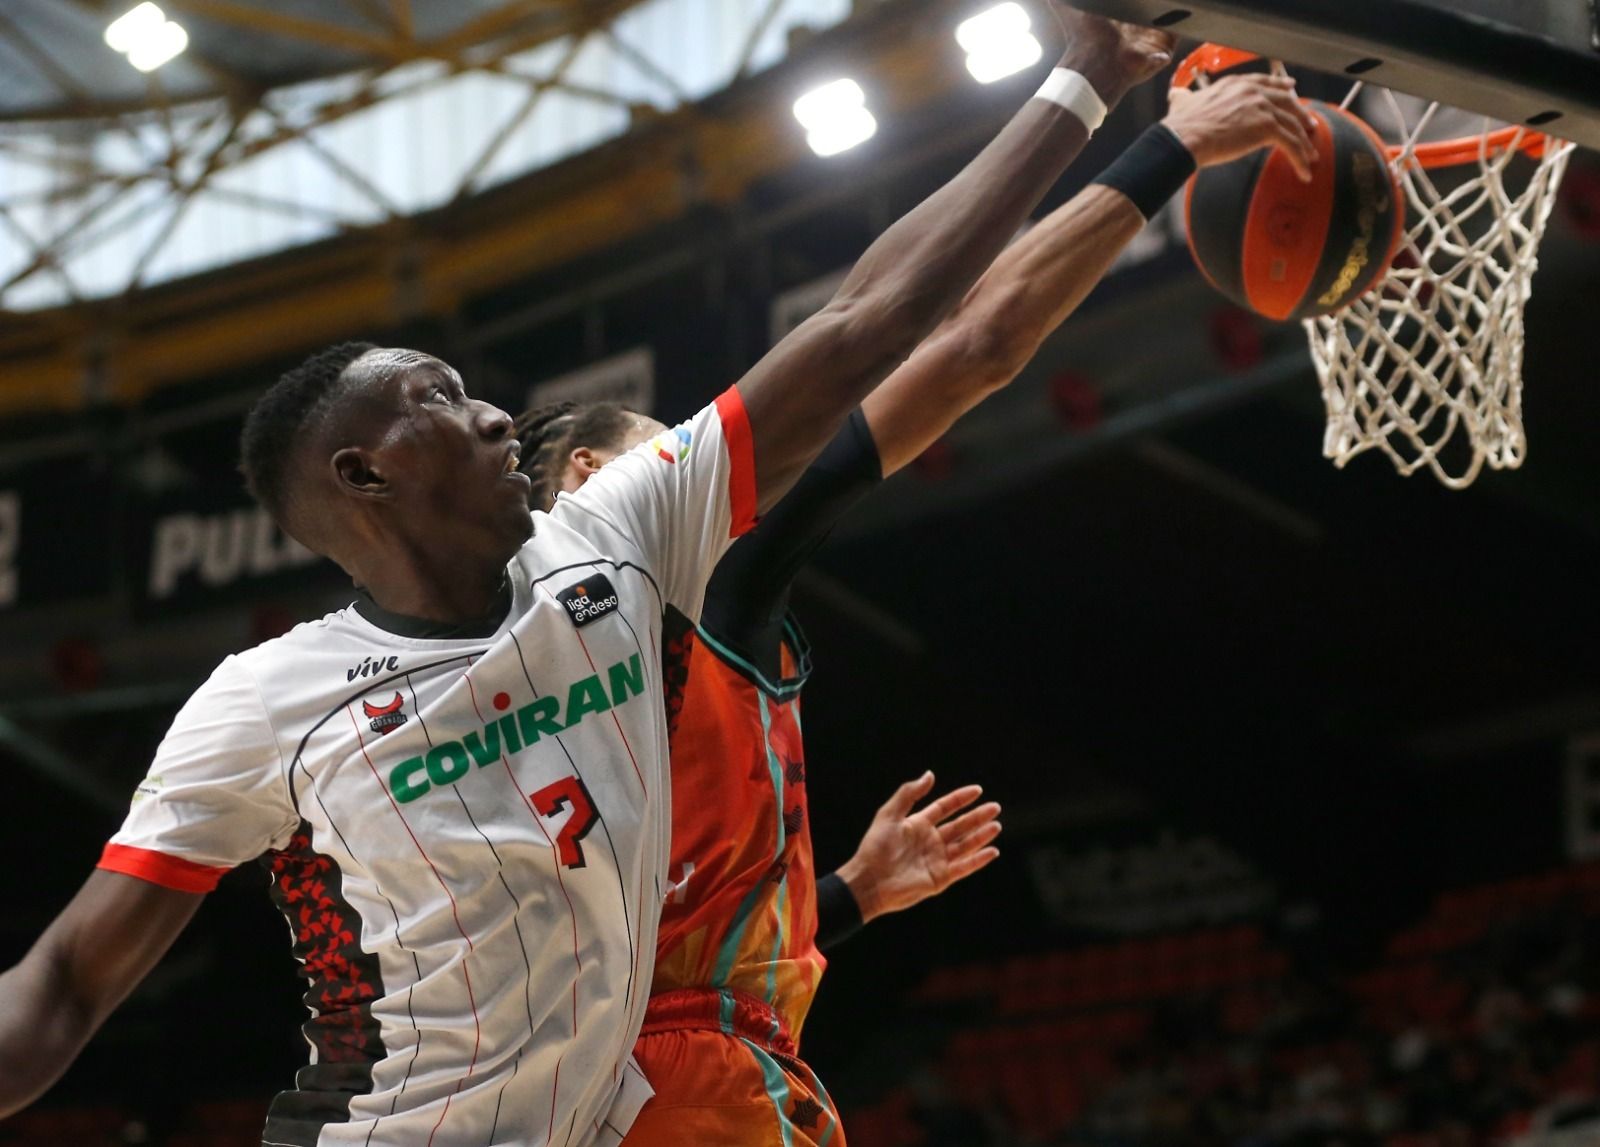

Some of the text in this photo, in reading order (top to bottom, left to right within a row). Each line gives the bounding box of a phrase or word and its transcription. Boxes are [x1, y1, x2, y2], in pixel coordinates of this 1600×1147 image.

[566, 595, 591, 611] liga
[575, 595, 618, 622] endesa
[529, 775, 601, 870] 7
